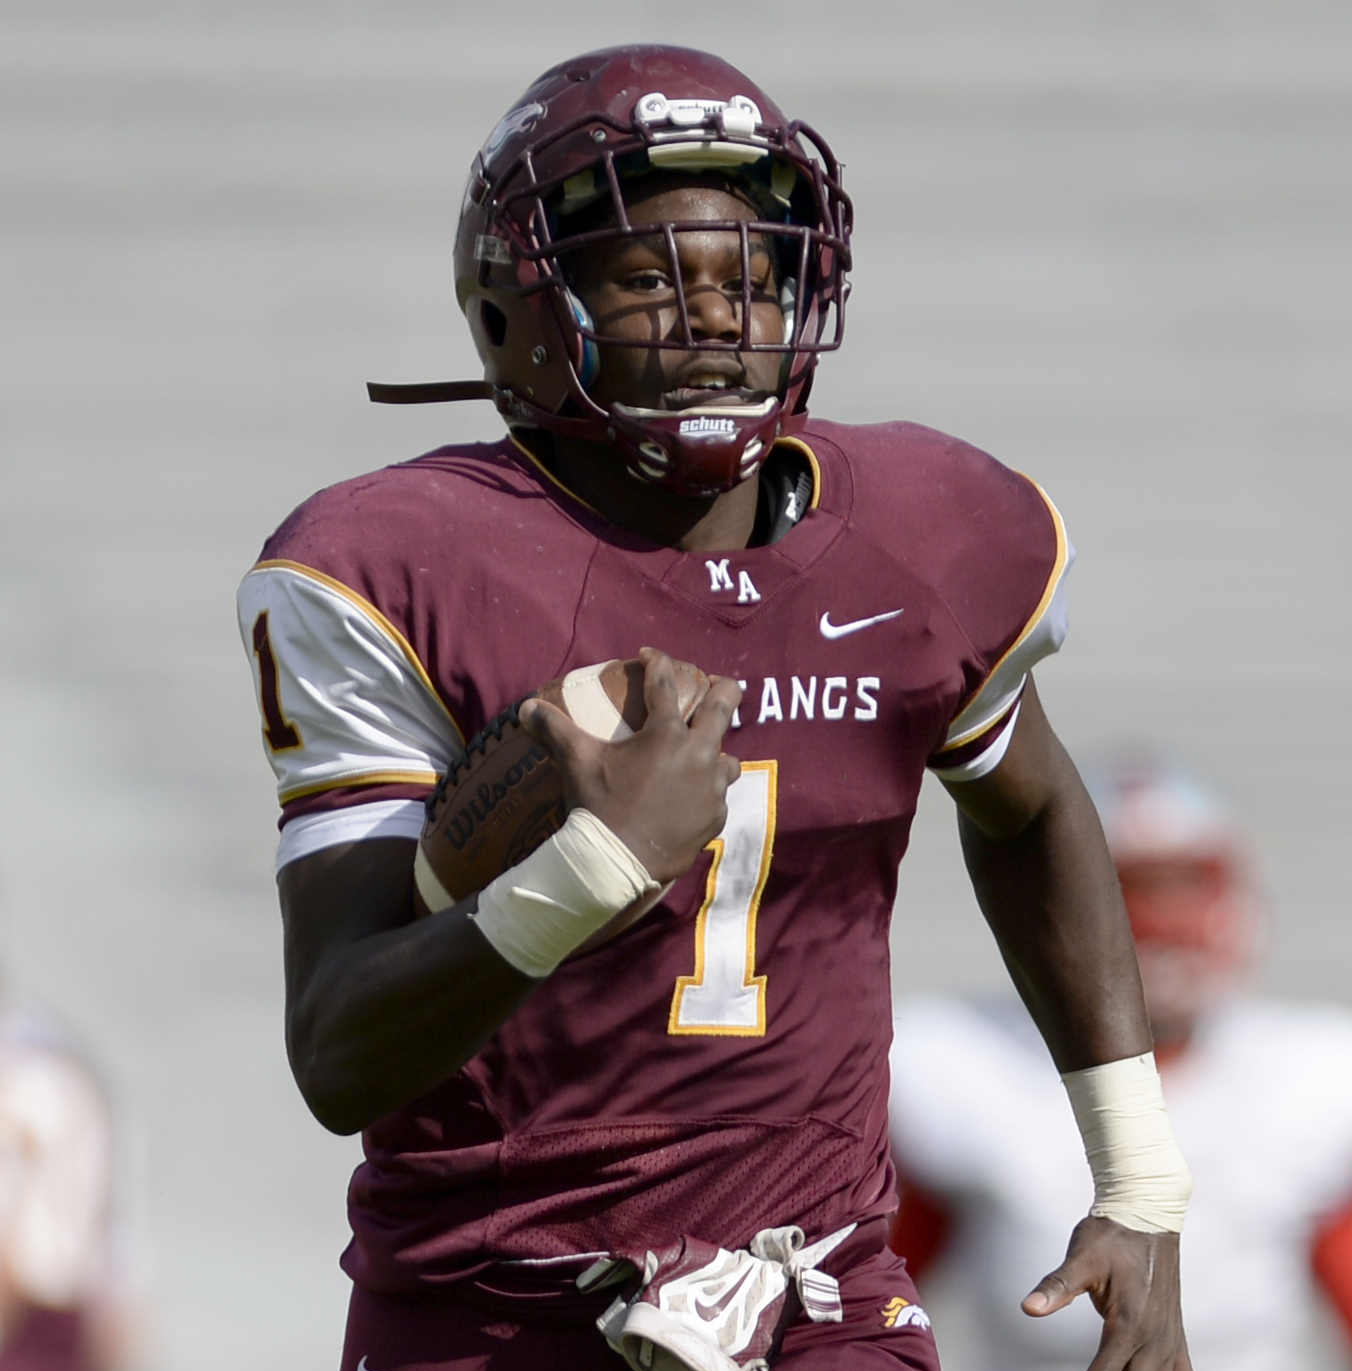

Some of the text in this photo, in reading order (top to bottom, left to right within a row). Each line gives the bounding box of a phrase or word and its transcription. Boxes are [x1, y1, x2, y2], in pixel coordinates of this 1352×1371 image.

[680, 416, 735, 432] schutt
[253, 608, 303, 754] 1
[444, 746, 548, 851] Wilson
[668, 760, 778, 1037] 1
